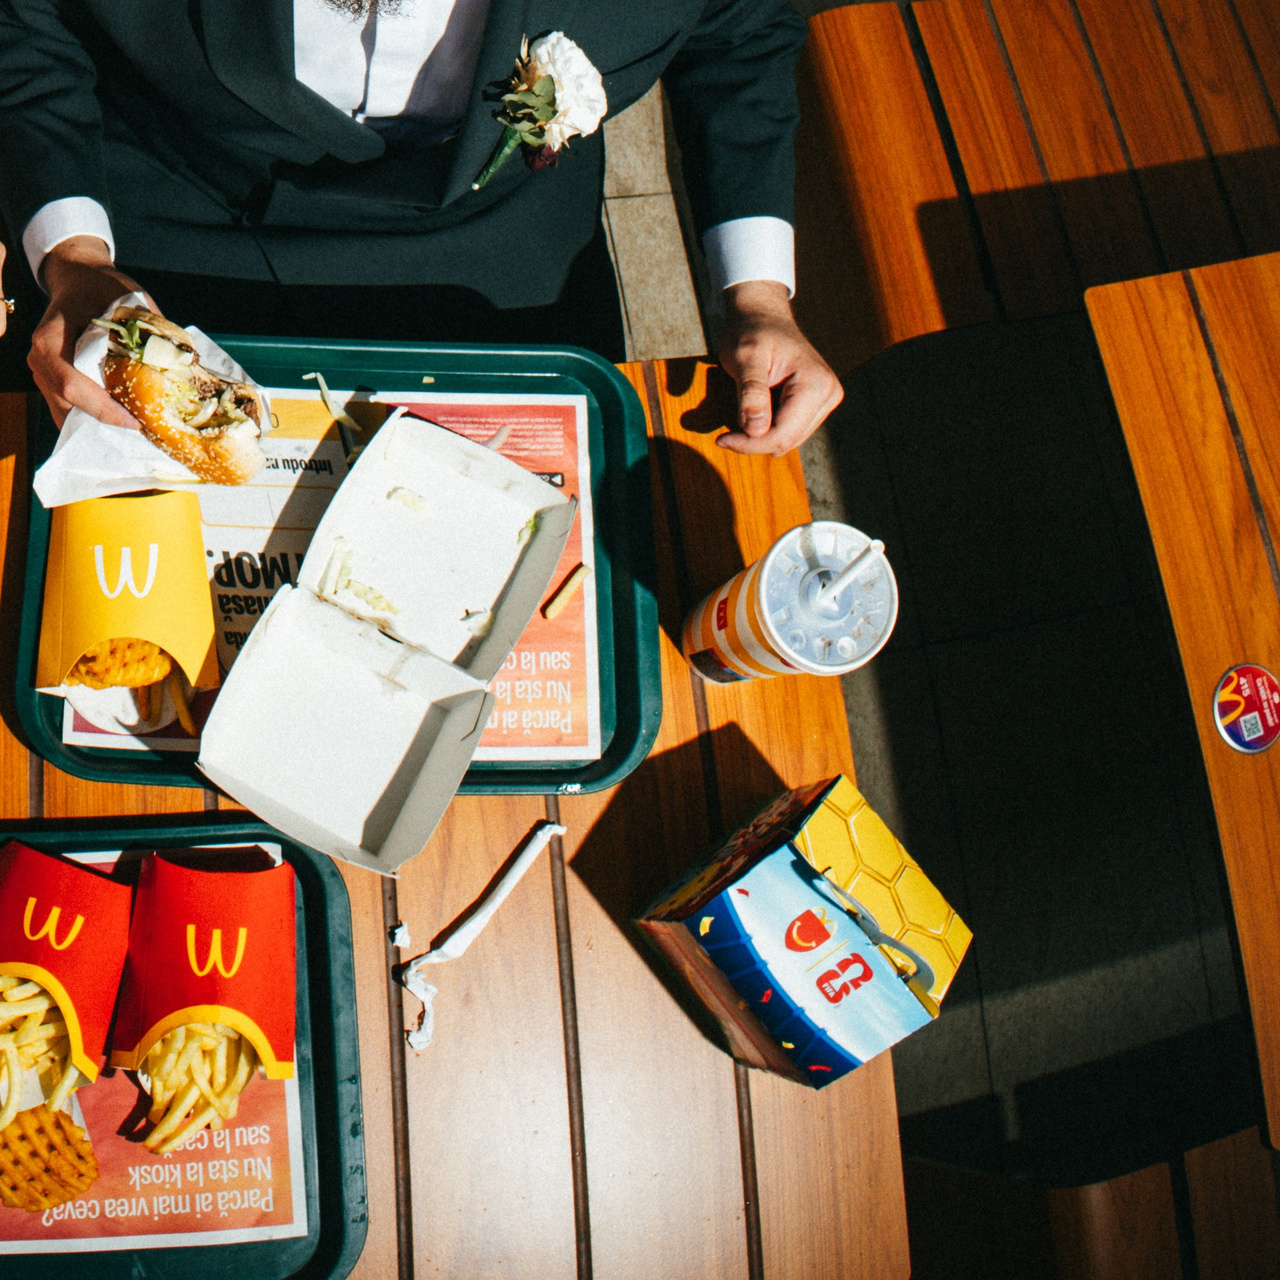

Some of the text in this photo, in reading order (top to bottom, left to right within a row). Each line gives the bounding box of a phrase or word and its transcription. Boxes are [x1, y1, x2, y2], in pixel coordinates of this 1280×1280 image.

[282, 459, 334, 475] Introdu
[520, 651, 536, 676] la
[539, 651, 571, 670] sau
[495, 680, 571, 705] Nu sta la
[1239, 676, 1251, 697] 415
[502, 710, 518, 734] ai
[522, 710, 572, 735] Parcă
[213, 1127, 230, 1153] la
[234, 1124, 270, 1146] sau
[127, 1156, 272, 1190] Nu sta la kiosk
[104, 1197, 149, 1218] vrea
[153, 1194, 191, 1220] mai
[195, 1192, 213, 1218] ai
[217, 1187, 274, 1217] Parcă
